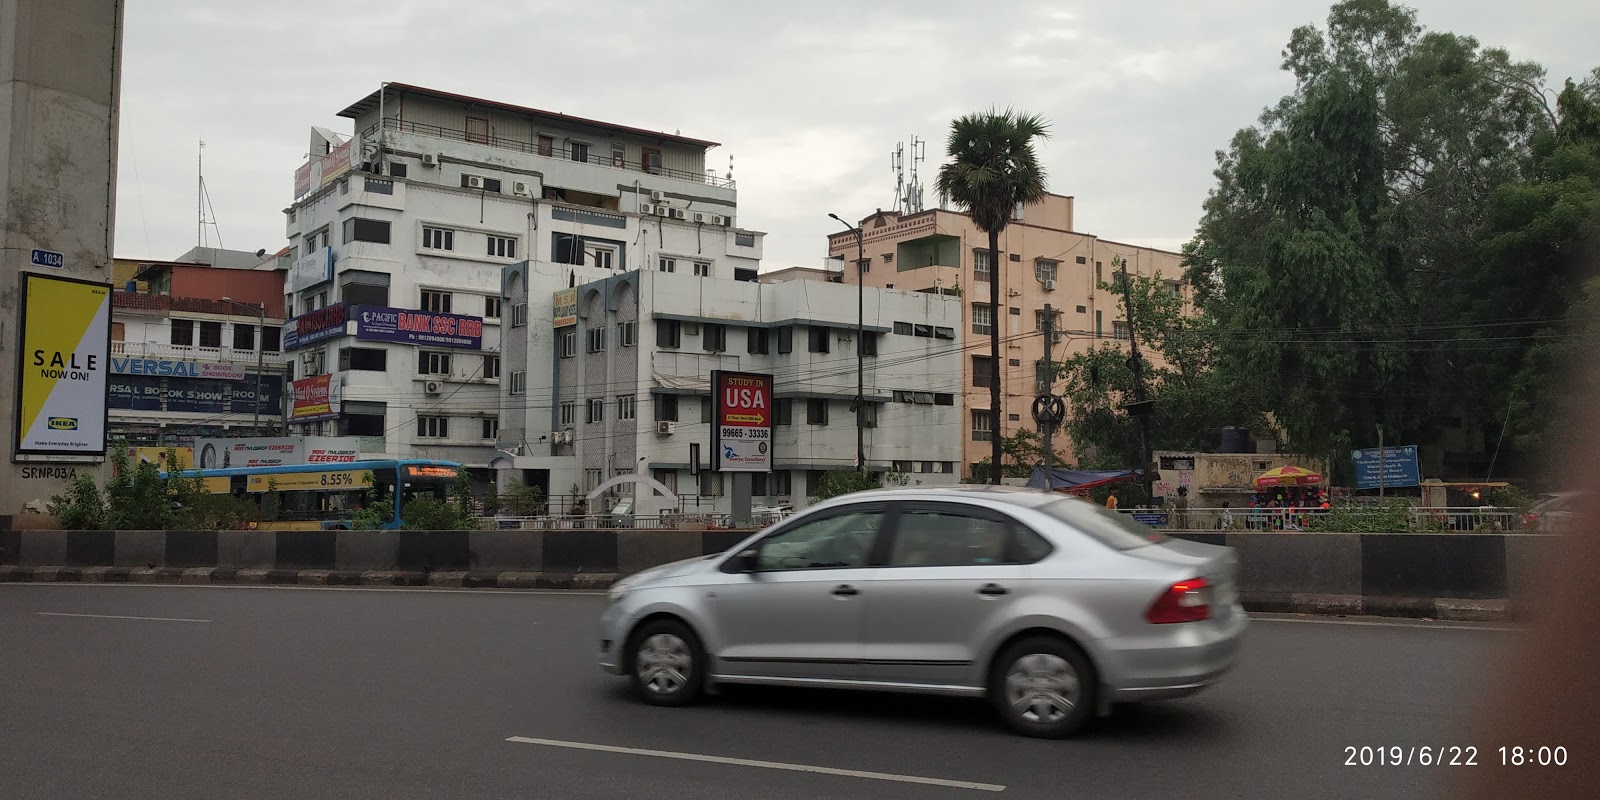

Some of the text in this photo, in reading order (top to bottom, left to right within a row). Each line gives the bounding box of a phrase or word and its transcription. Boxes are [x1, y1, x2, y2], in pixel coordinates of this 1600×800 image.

[33, 252, 62, 266] A 1034
[372, 312, 482, 338] PACIFIC BANK SSC RRB
[33, 350, 97, 371] SALE
[112, 358, 199, 377] VERSAL
[41, 369, 89, 381] NOW ON!
[202, 370, 243, 379] SHOWROOM
[728, 377, 764, 387] STUDY IN
[726, 387, 765, 409] USA
[722, 428, 743, 438] 99665
[748, 429, 769, 439] 33336
[308, 454, 356, 462] EZEERIDE
[320, 473, 353, 486] 8.55%
